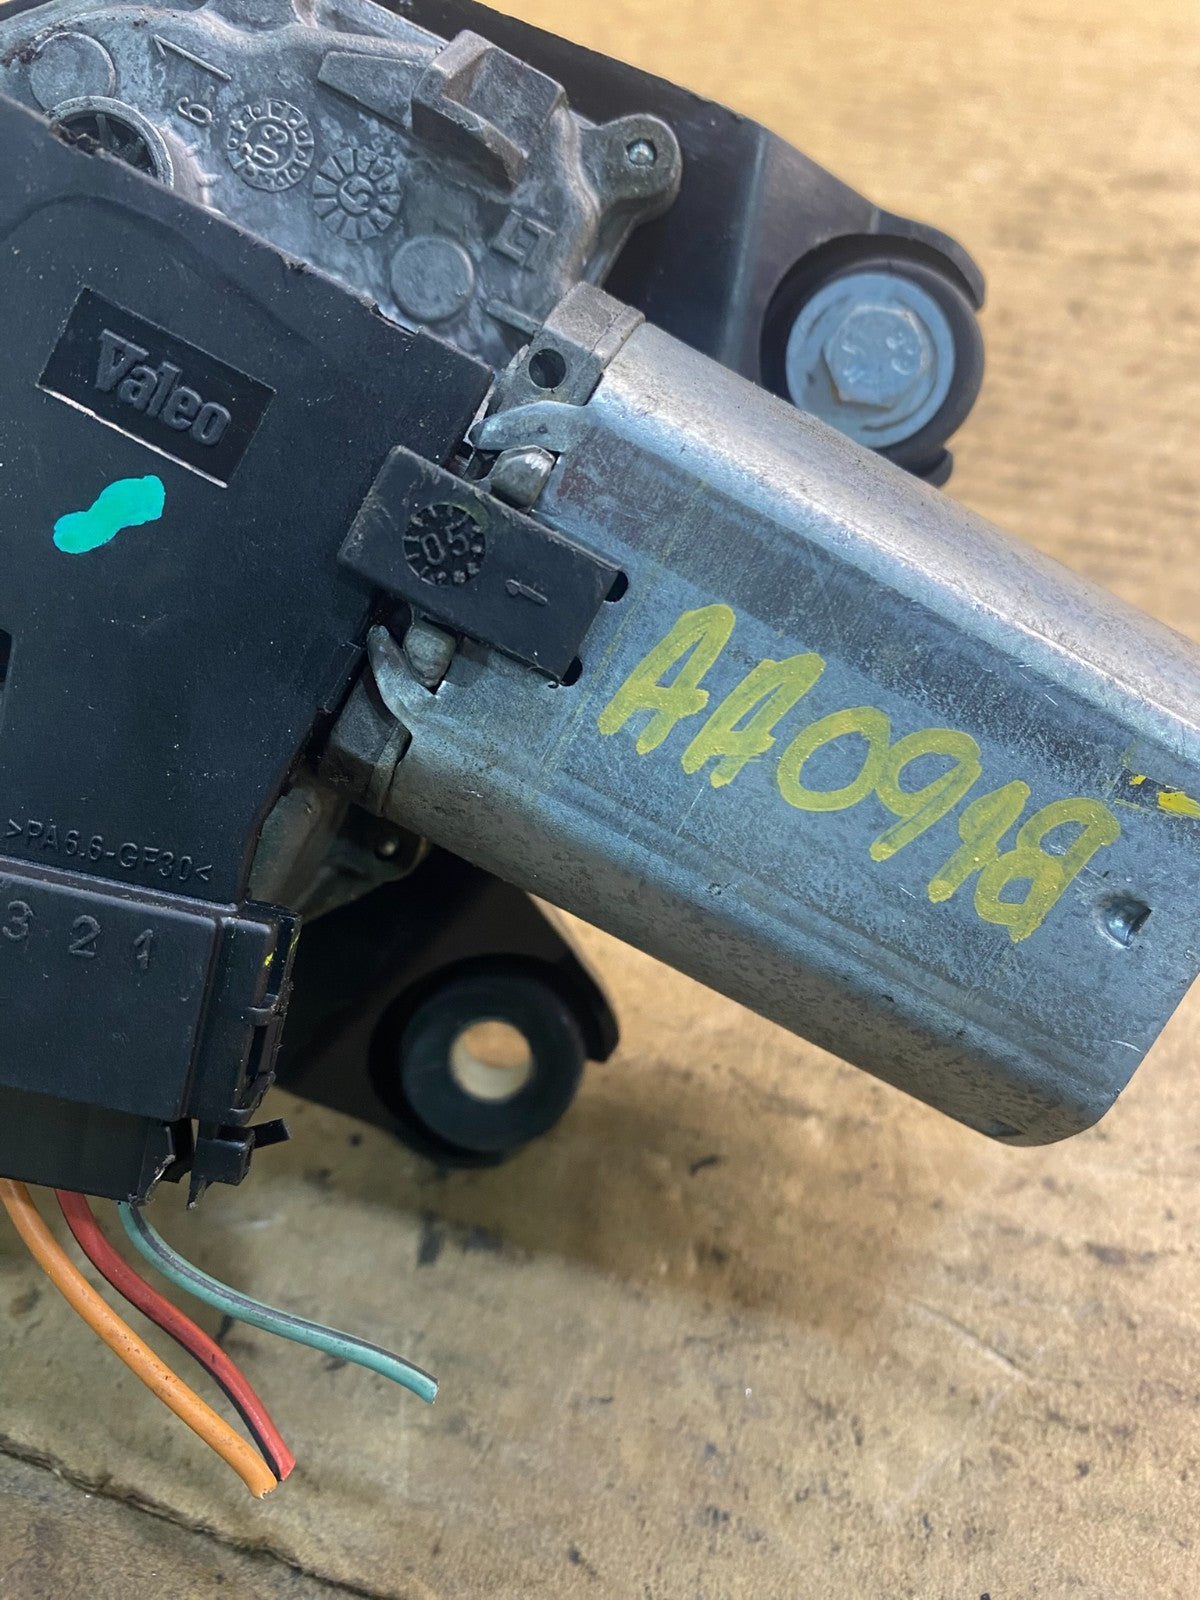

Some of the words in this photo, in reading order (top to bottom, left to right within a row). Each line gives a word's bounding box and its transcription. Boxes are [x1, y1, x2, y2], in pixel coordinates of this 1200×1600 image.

[95, 328, 231, 446] Valeo
[2, 900, 34, 941] 3
[69, 914, 102, 958] 2
[133, 928, 154, 970] 1
